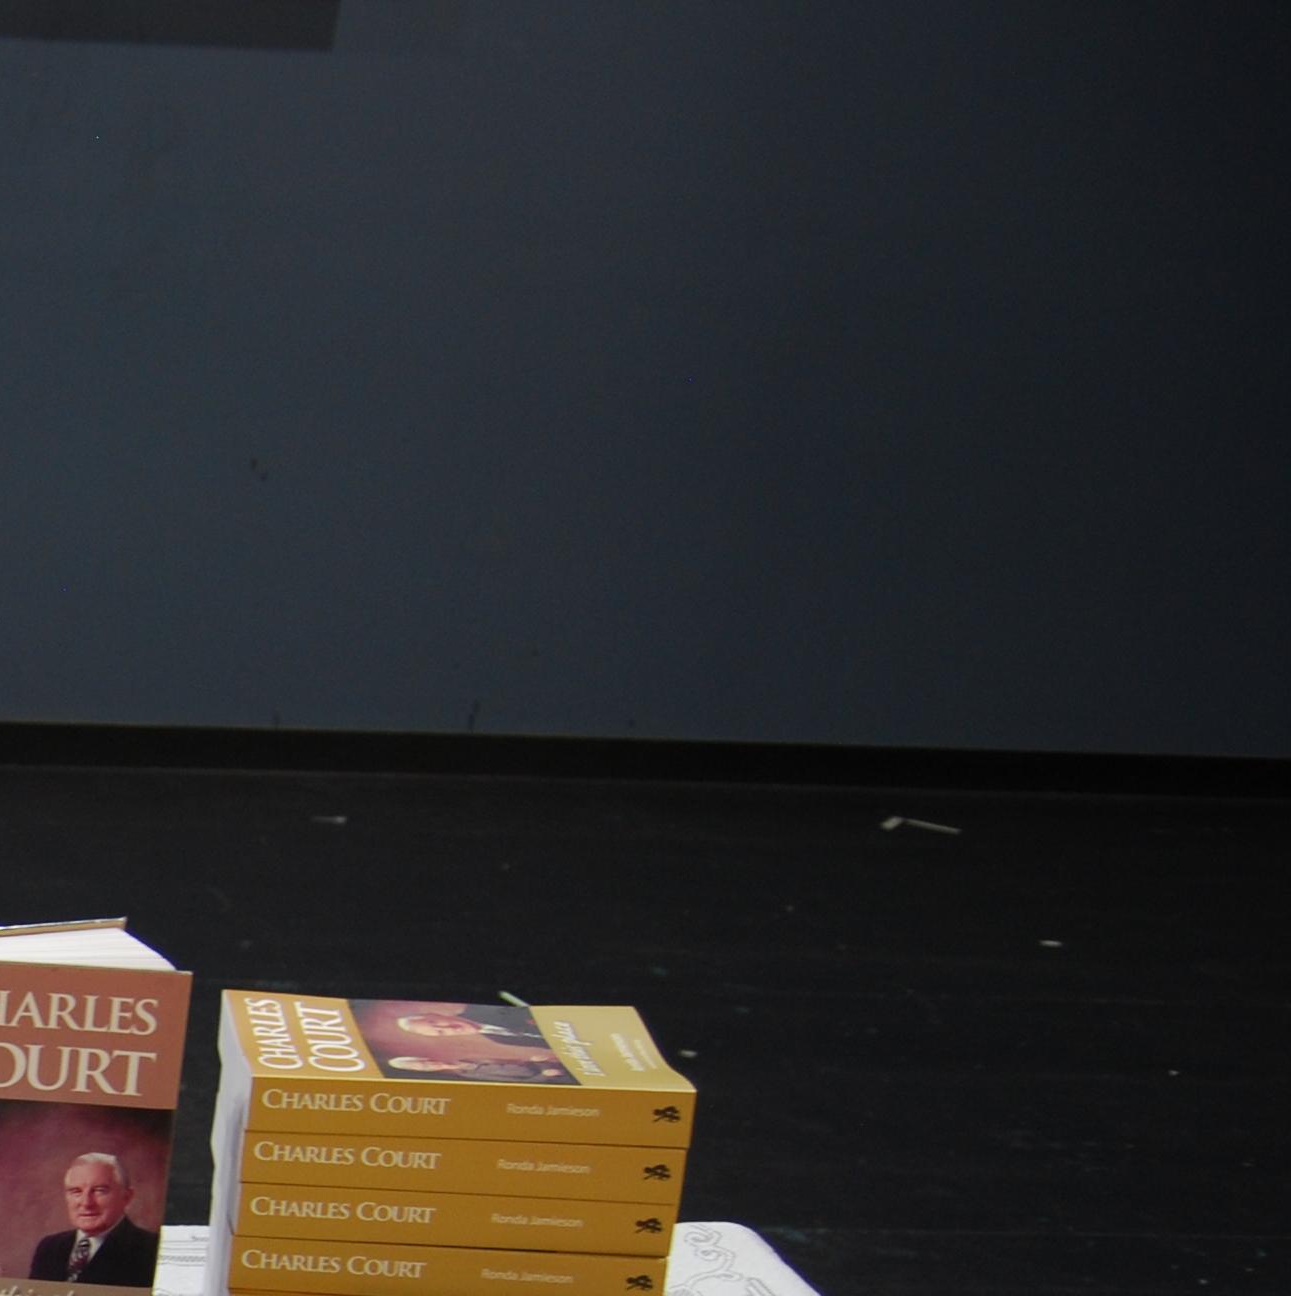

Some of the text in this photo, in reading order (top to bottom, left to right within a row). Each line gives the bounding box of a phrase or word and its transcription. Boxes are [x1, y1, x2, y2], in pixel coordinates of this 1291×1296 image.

[244, 997, 303, 1070] CHARLES
[294, 1001, 366, 1073] COURT
[262, 1088, 451, 1115] CHARLES COURT
[506, 1103, 600, 1117] Ronda Jamieson
[254, 1141, 442, 1169] CHARLES COURT
[497, 1158, 535, 1171] Ronda
[250, 1196, 436, 1224] CHARLES COURT
[491, 1213, 529, 1226] Ronda
[241, 1249, 427, 1278] CHARLES COURT
